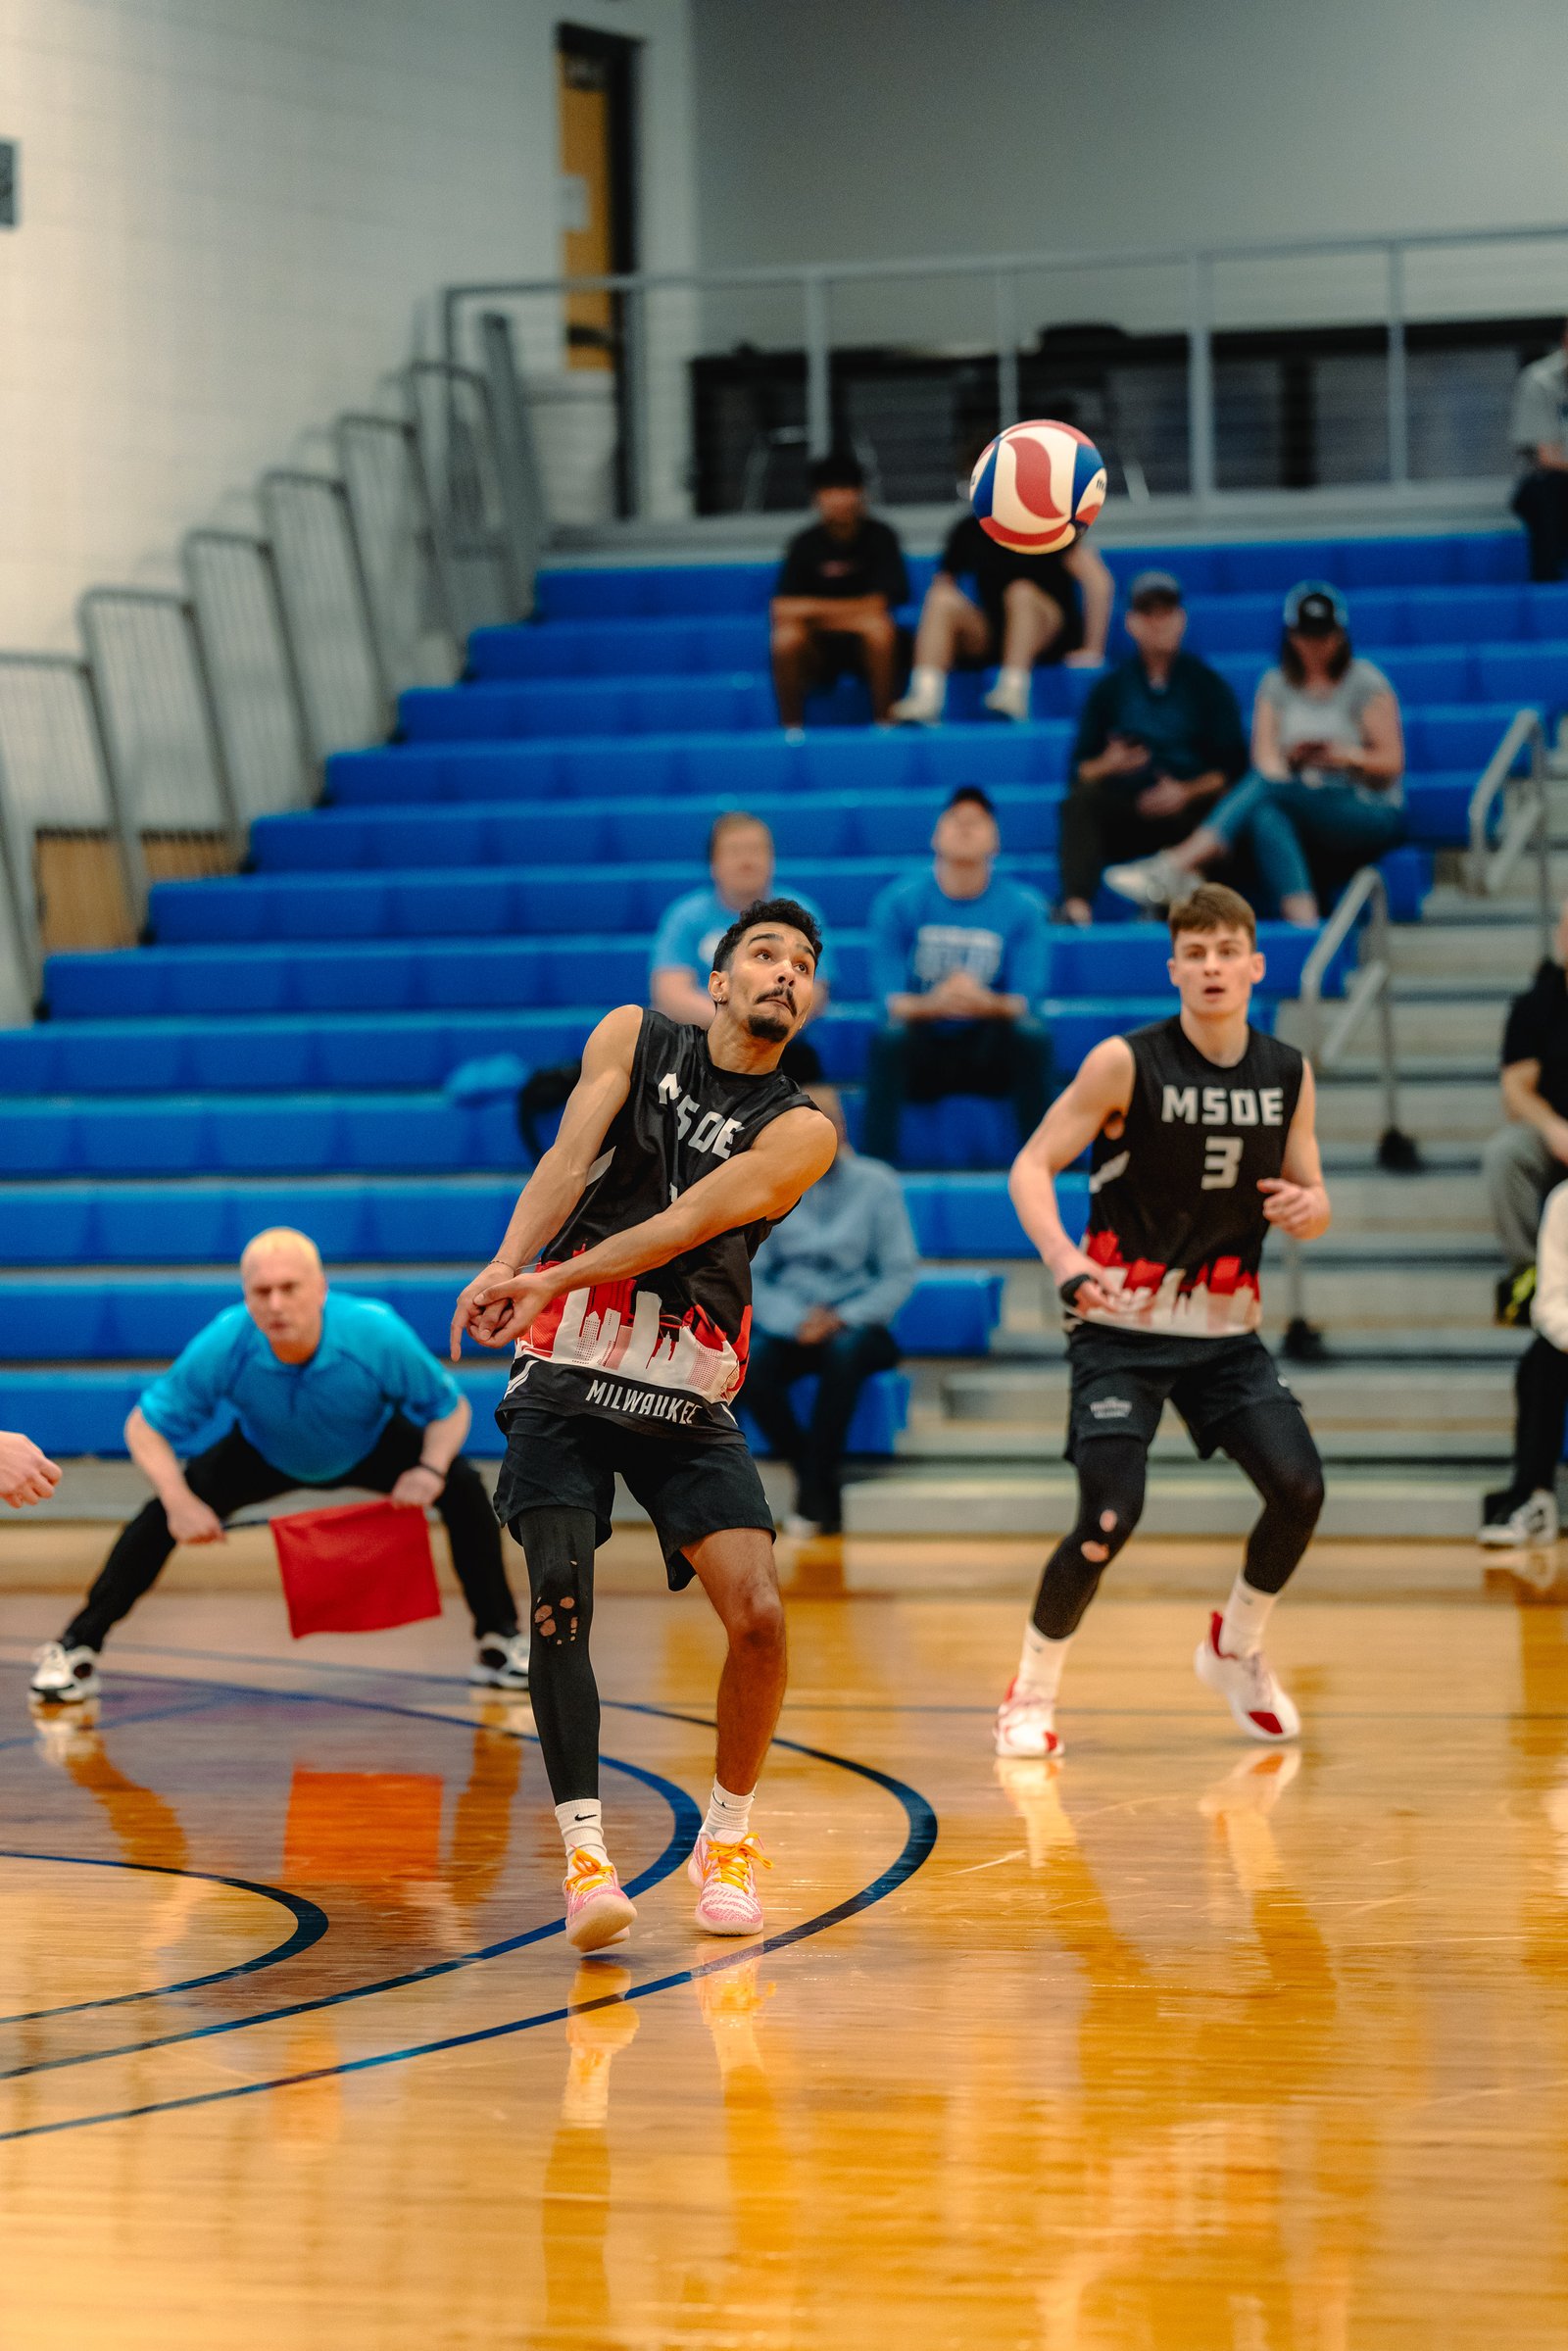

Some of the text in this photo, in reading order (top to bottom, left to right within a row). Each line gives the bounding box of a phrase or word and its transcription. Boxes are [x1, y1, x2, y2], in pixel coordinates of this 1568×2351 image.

[659, 1073, 745, 1159] MSOE
[1161, 1084, 1284, 1126] MSOE
[1200, 1136, 1244, 1190] 3
